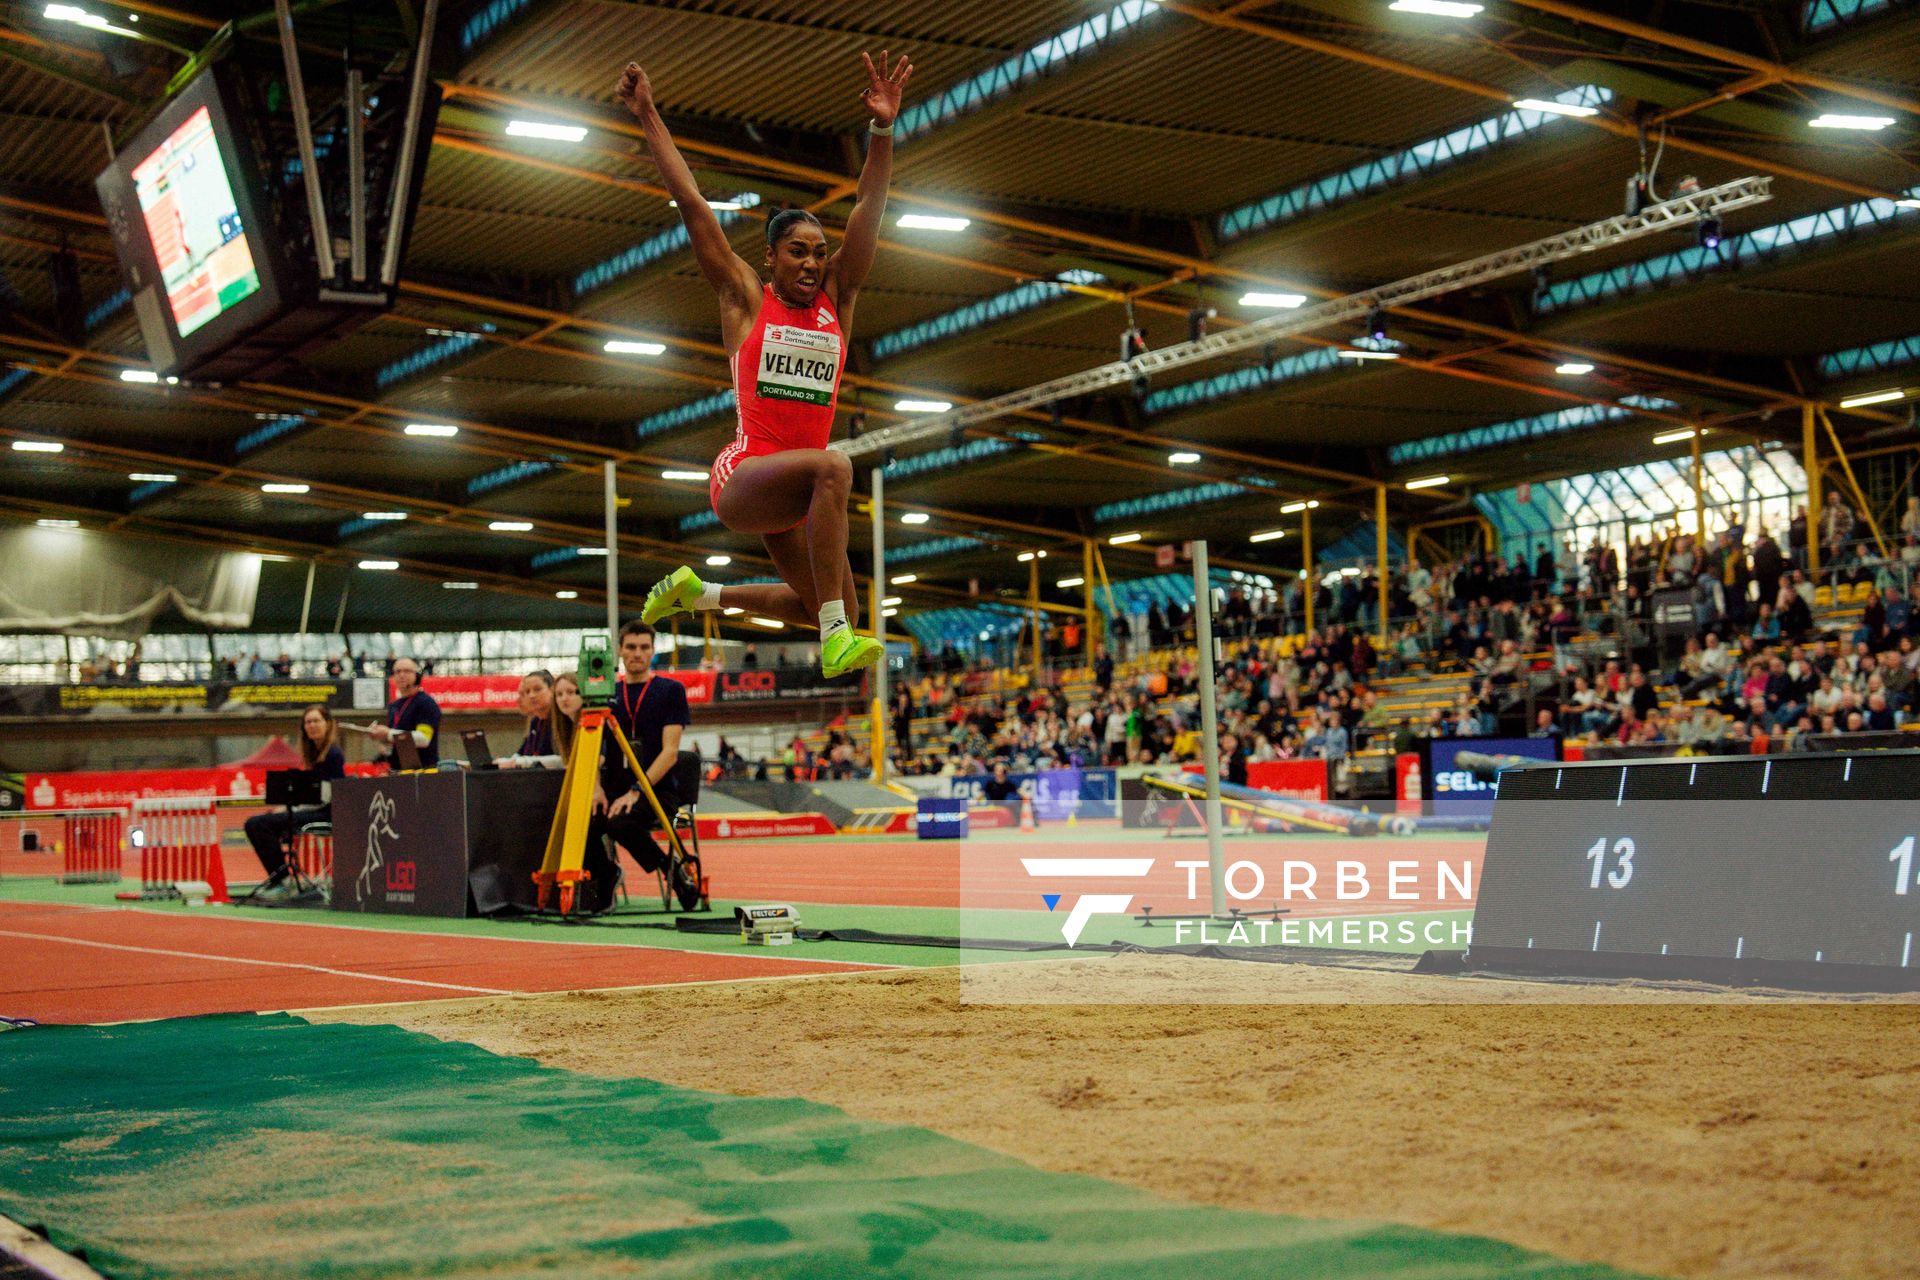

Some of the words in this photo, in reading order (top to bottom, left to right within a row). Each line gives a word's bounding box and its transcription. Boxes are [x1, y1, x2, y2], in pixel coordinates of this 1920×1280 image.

[784, 336, 815, 346] Dortmund
[785, 328, 805, 337] Indoor
[806, 332, 830, 343] Meeting
[765, 352, 835, 382] VELAZCO
[763, 386, 805, 398] DORTMUND
[1586, 837, 1636, 889] 13
[1889, 836, 1920, 895] 1
